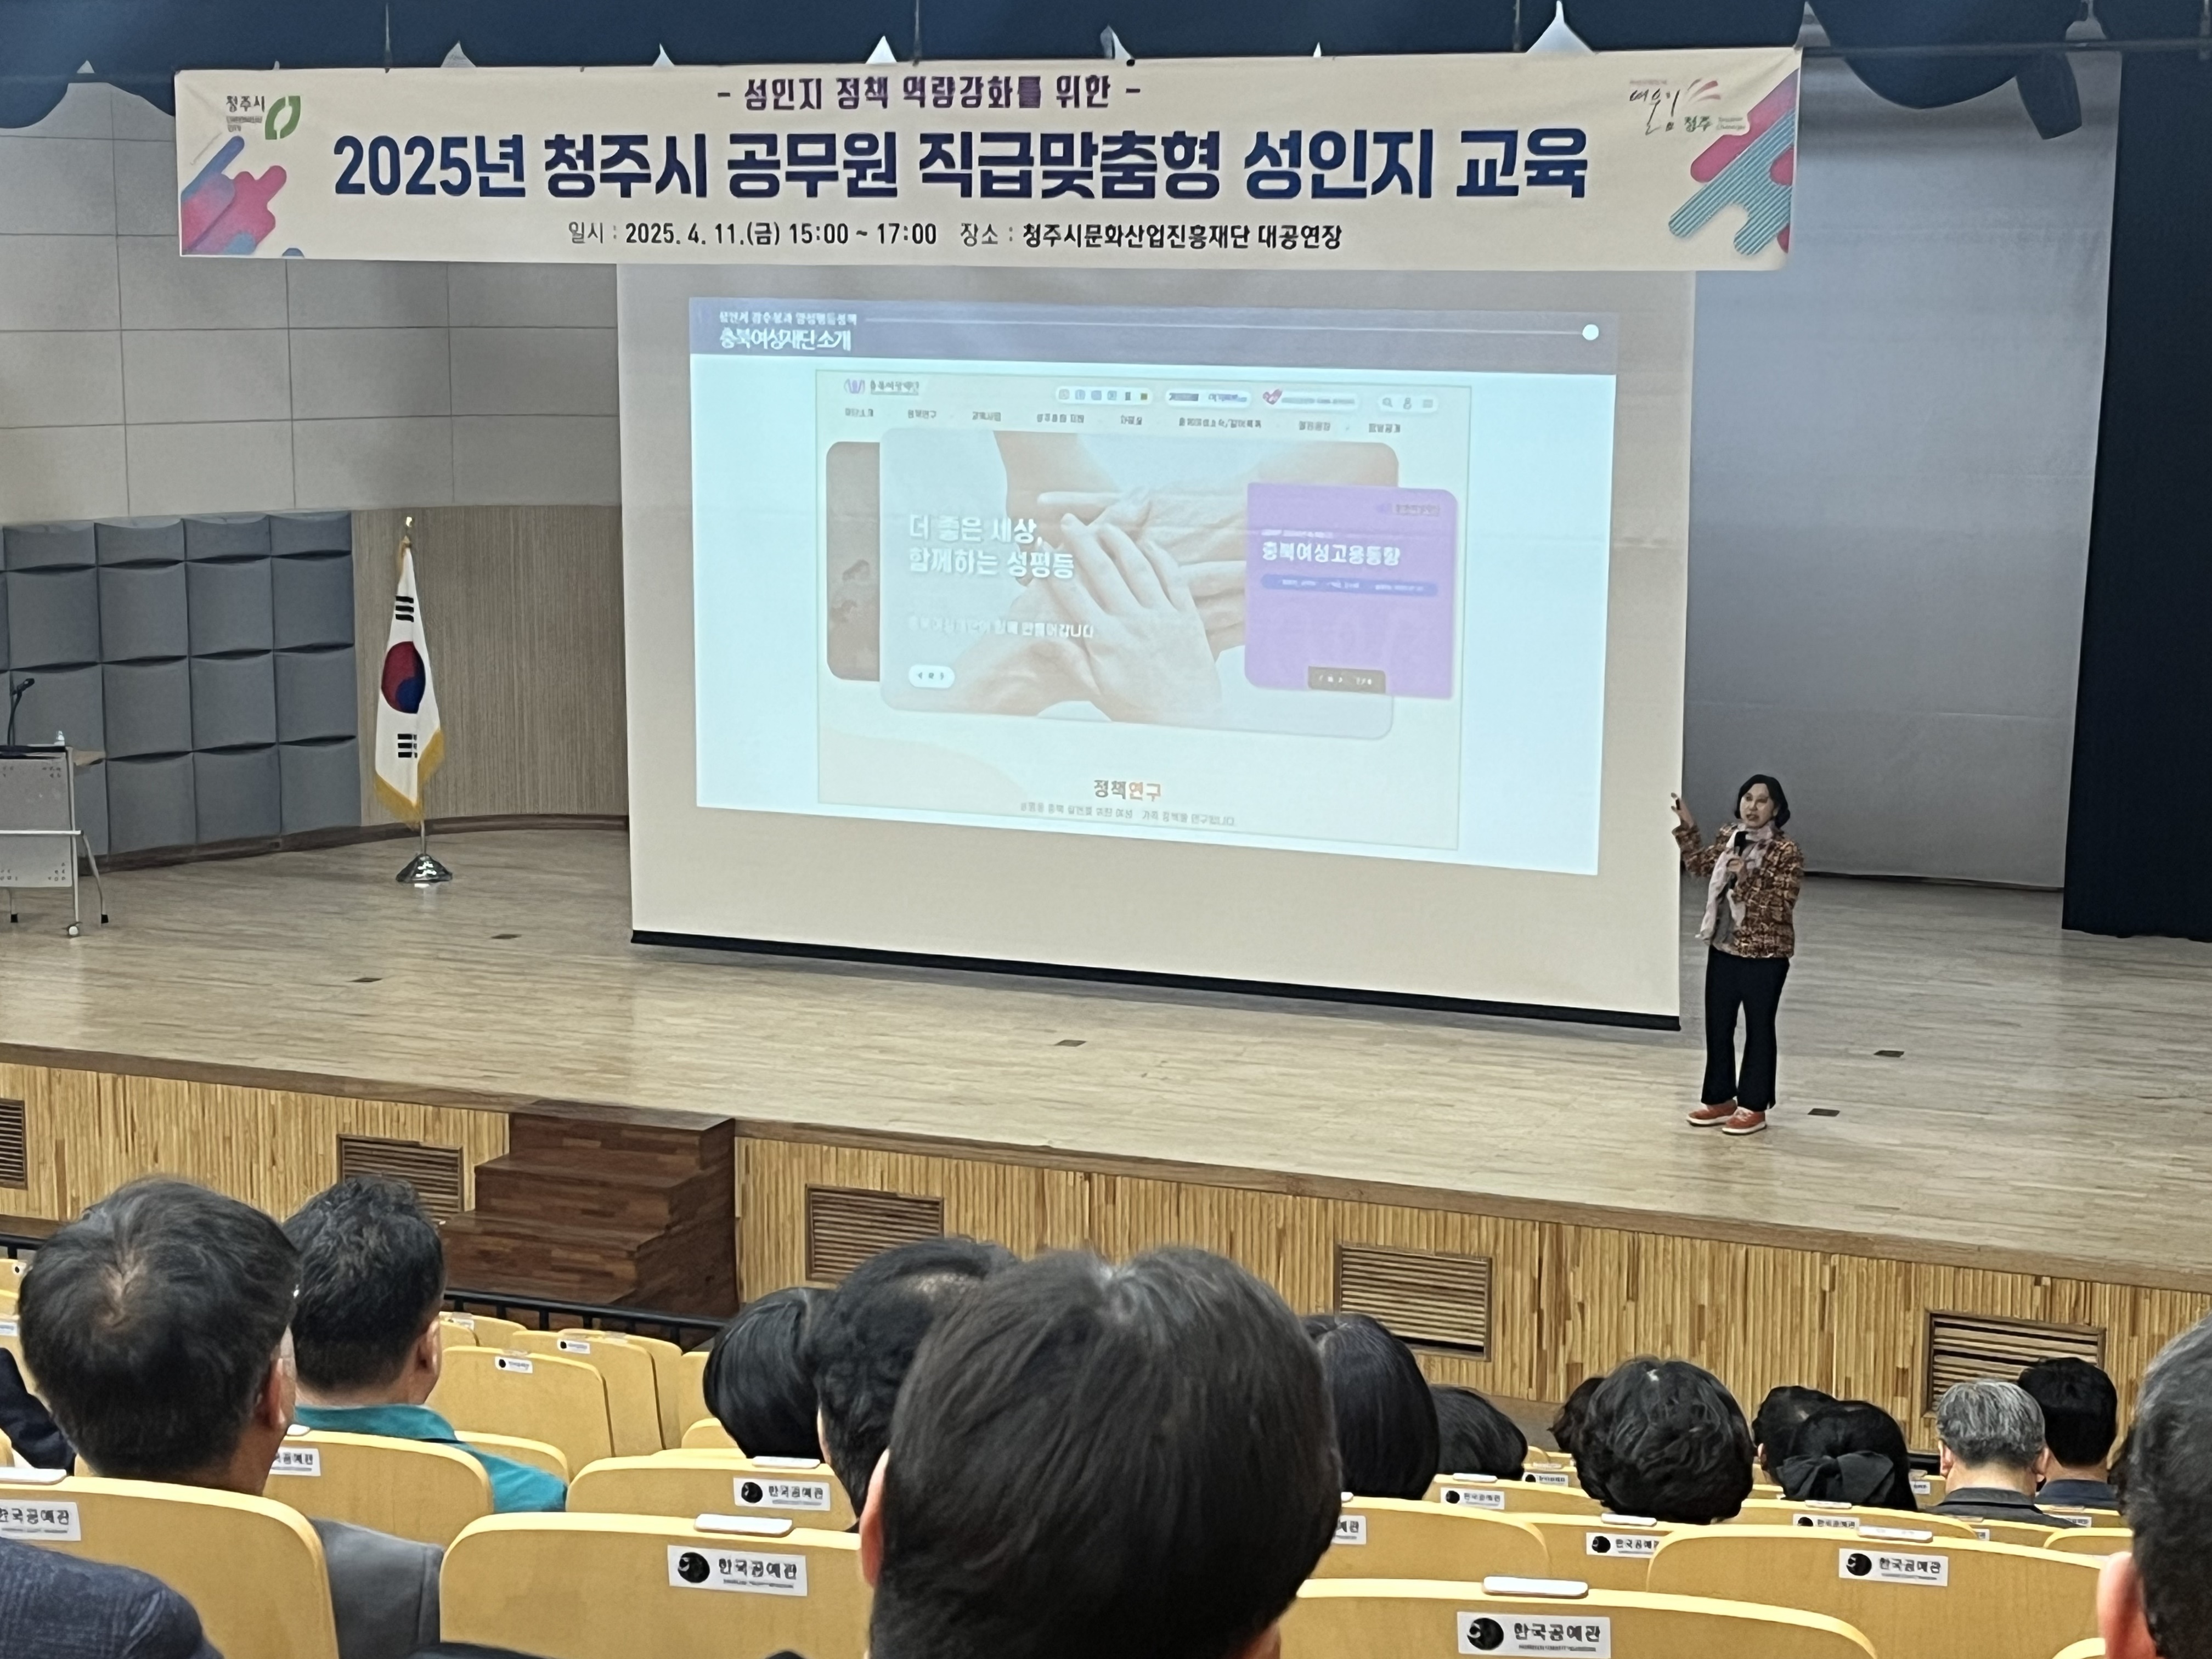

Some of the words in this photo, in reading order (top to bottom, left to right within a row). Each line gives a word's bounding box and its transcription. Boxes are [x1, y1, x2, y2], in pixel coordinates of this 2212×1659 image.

[227, 96, 264, 112] 청주시
[745, 78, 821, 110] 성인지
[837, 77, 888, 109] 정책
[904, 76, 1041, 108] 역량강화를
[1057, 75, 1110, 108] 위한
[334, 134, 526, 197] 2025년
[545, 134, 707, 198] 청주시
[727, 132, 898, 198] 공무원
[919, 131, 1220, 199] 직급맞춤형
[1244, 129, 1433, 199] 성인지
[1457, 128, 1588, 198] 교육
[569, 222, 602, 244] 일시
[626, 223, 680, 244] 2025.
[688, 223, 706, 244] 4.
[715, 222, 779, 245] 11.(금)
[790, 223, 848, 244] 15:00
[878, 223, 936, 244] 17:00
[961, 223, 997, 246] 장소
[1023, 223, 1250, 249] 청주시문화산업진흥재단
[1259, 225, 1342, 250] 대공연장
[910, 514, 929, 540] 더
[938, 515, 983, 542] 좋은
[992, 517, 1043, 546] 세상,
[909, 548, 998, 575] 함께하는
[1007, 551, 1075, 579] 성평등
[1094, 780, 1161, 802] 정책연구
[275, 1452, 313, 1466] 공예관
[719, 1559, 797, 1581] 한국공예관
[1514, 1622, 1601, 1643] 한국공예관
